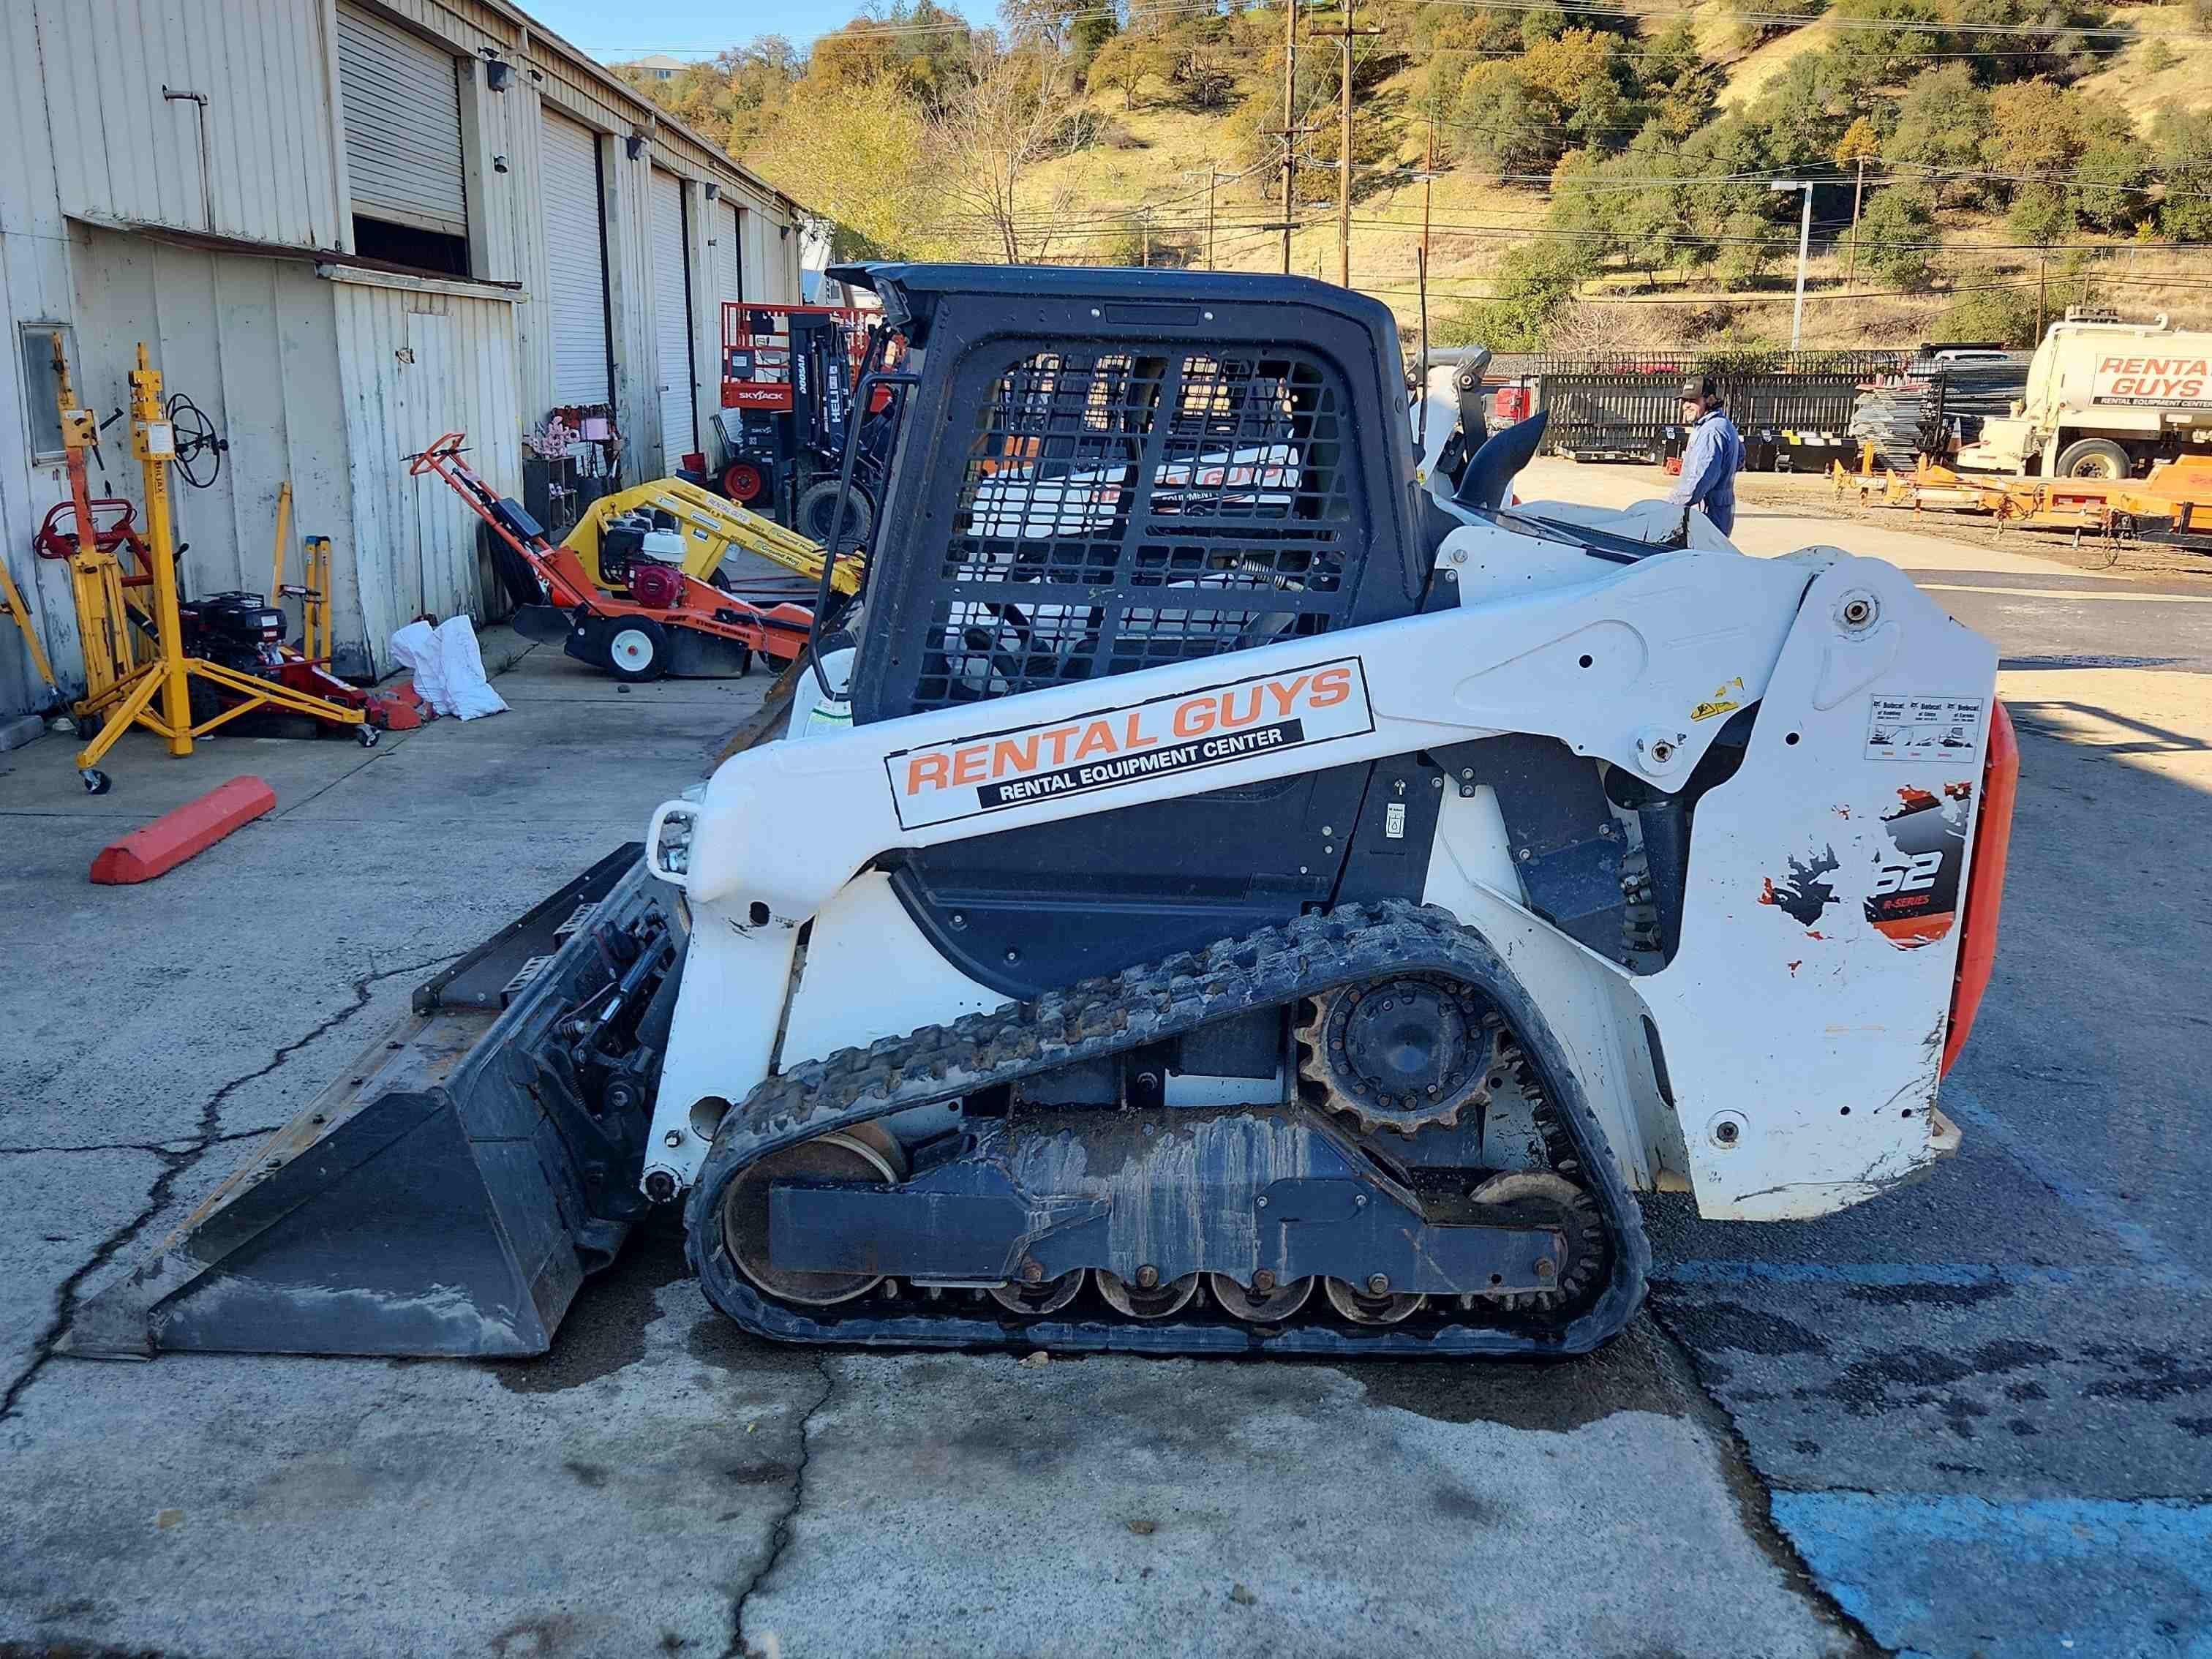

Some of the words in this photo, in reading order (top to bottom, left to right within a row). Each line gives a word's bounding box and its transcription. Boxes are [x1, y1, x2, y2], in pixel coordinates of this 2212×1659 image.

[797, 354, 808, 394] DOOSAN
[2099, 358, 2212, 376] RENTA
[739, 391, 783, 400] SKYJACK
[2111, 378, 2203, 397] GUYS
[831, 391, 841, 423] HELI
[2132, 399, 2182, 407] EQUIPMENT
[761, 545, 785, 558] Ground
[907, 712, 1159, 796] RENTAL
[1173, 668, 1352, 737] GUYS
[999, 775, 1077, 801] RENTAL
[1080, 745, 1198, 785] EQUIPMENT
[1203, 728, 1283, 758] CENTER
